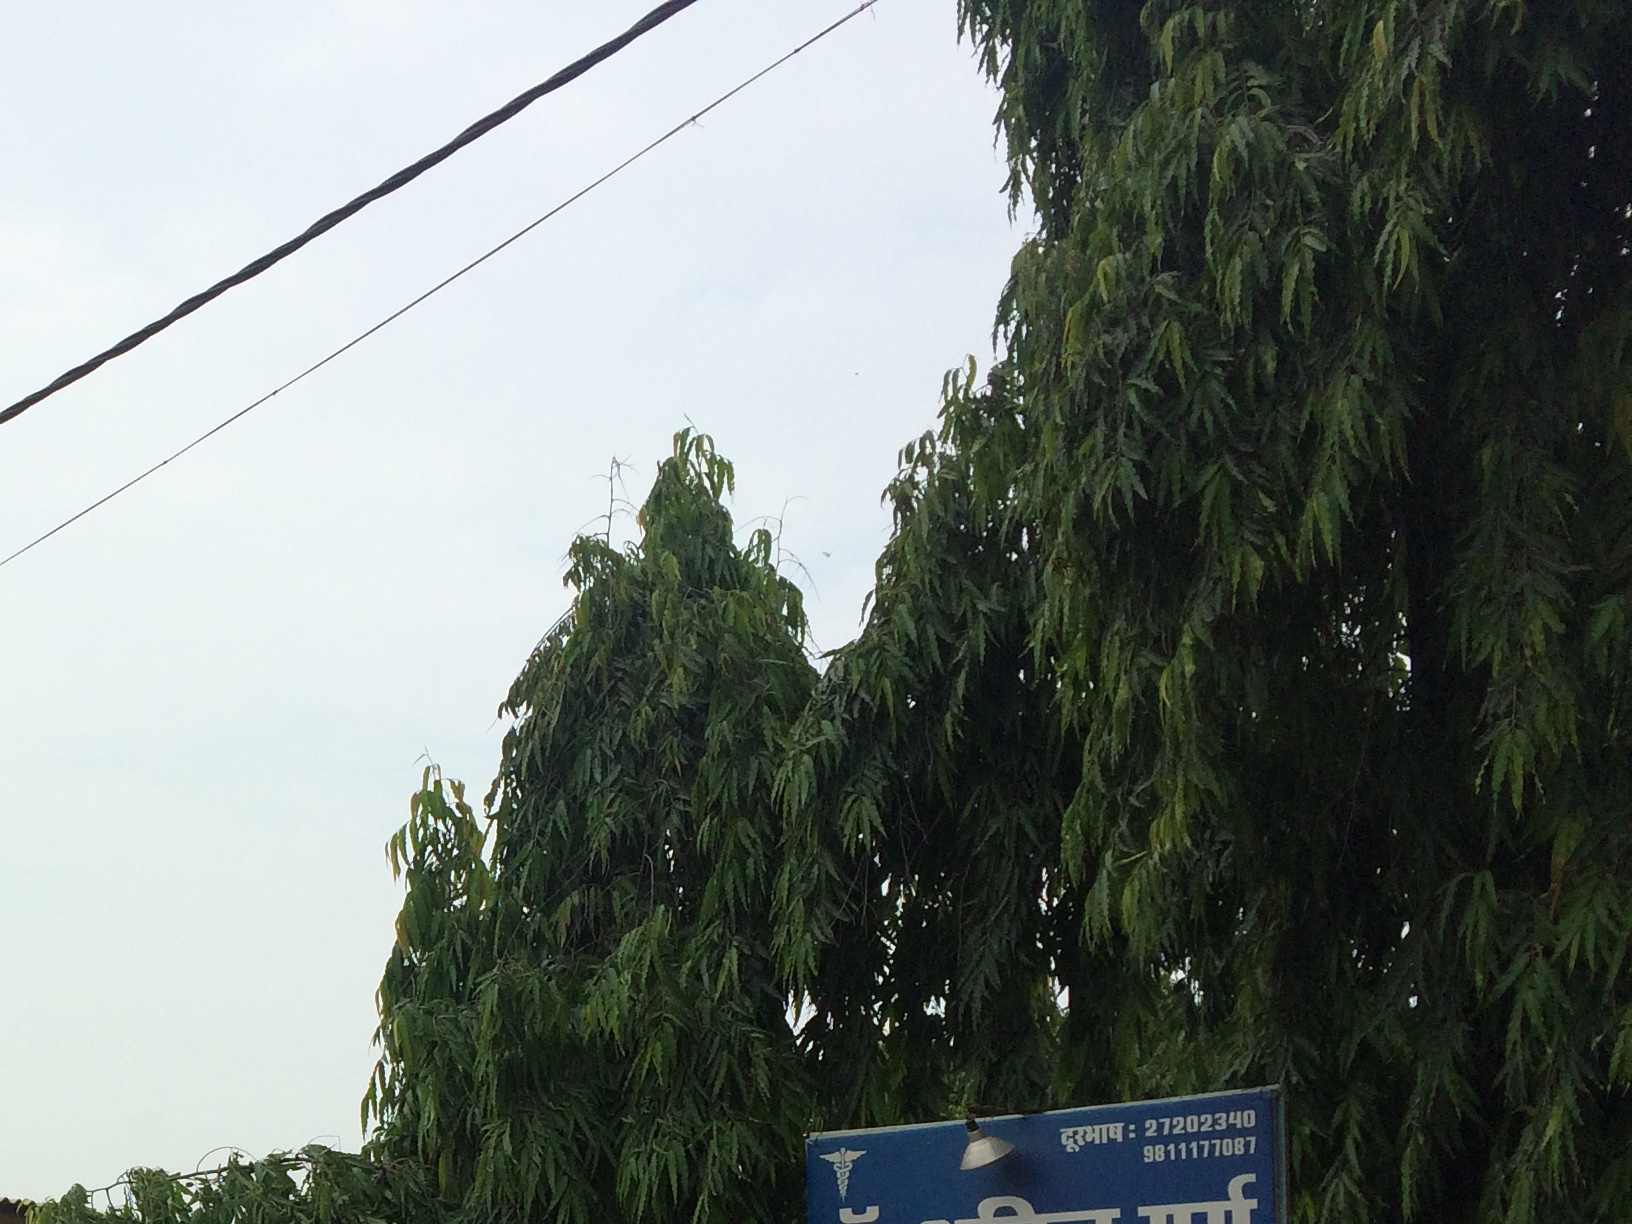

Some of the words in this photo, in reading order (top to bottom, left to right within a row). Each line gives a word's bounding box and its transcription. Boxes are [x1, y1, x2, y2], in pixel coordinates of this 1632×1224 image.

[1060, 1123, 1124, 1152] दूरभाष
[1145, 1110, 1255, 1136] 27202340
[1144, 1136, 1256, 1162] 9811177087
